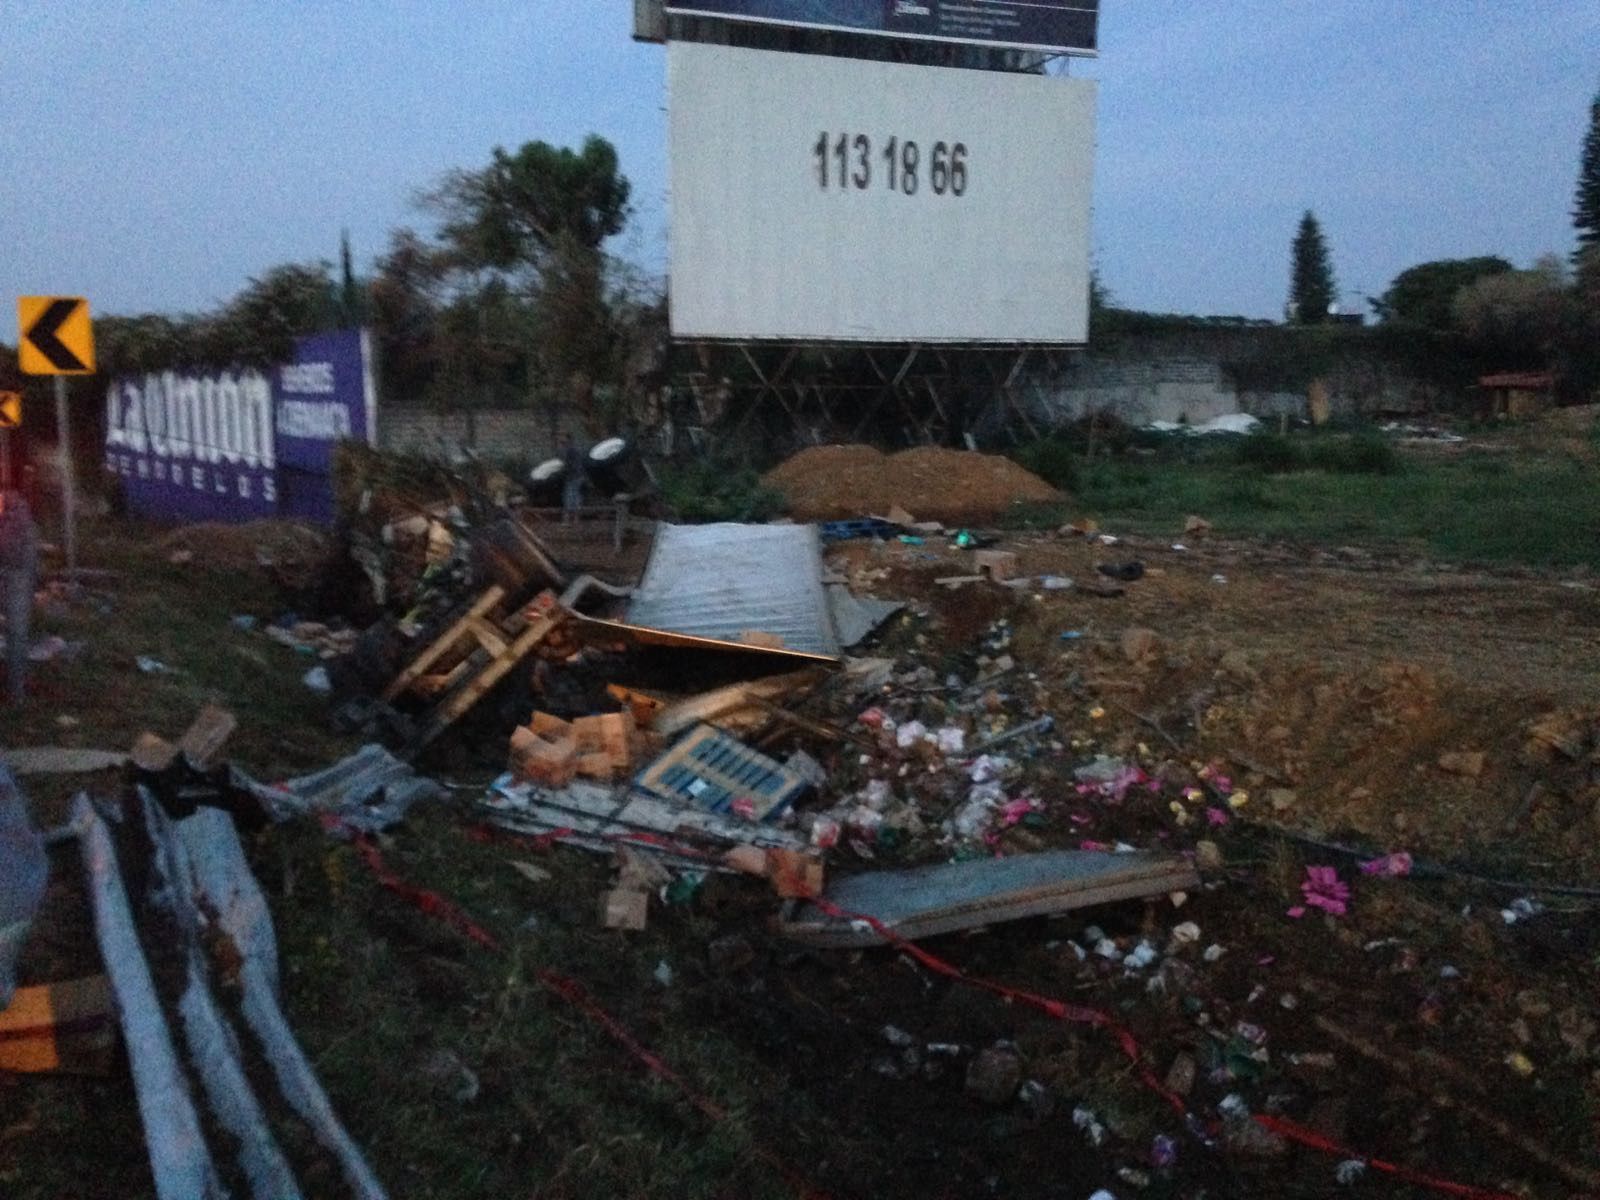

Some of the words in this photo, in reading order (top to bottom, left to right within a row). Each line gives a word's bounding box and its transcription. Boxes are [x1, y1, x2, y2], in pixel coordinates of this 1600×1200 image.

[814, 131, 870, 190] 113
[884, 135, 919, 195] 18
[931, 140, 968, 196] 66
